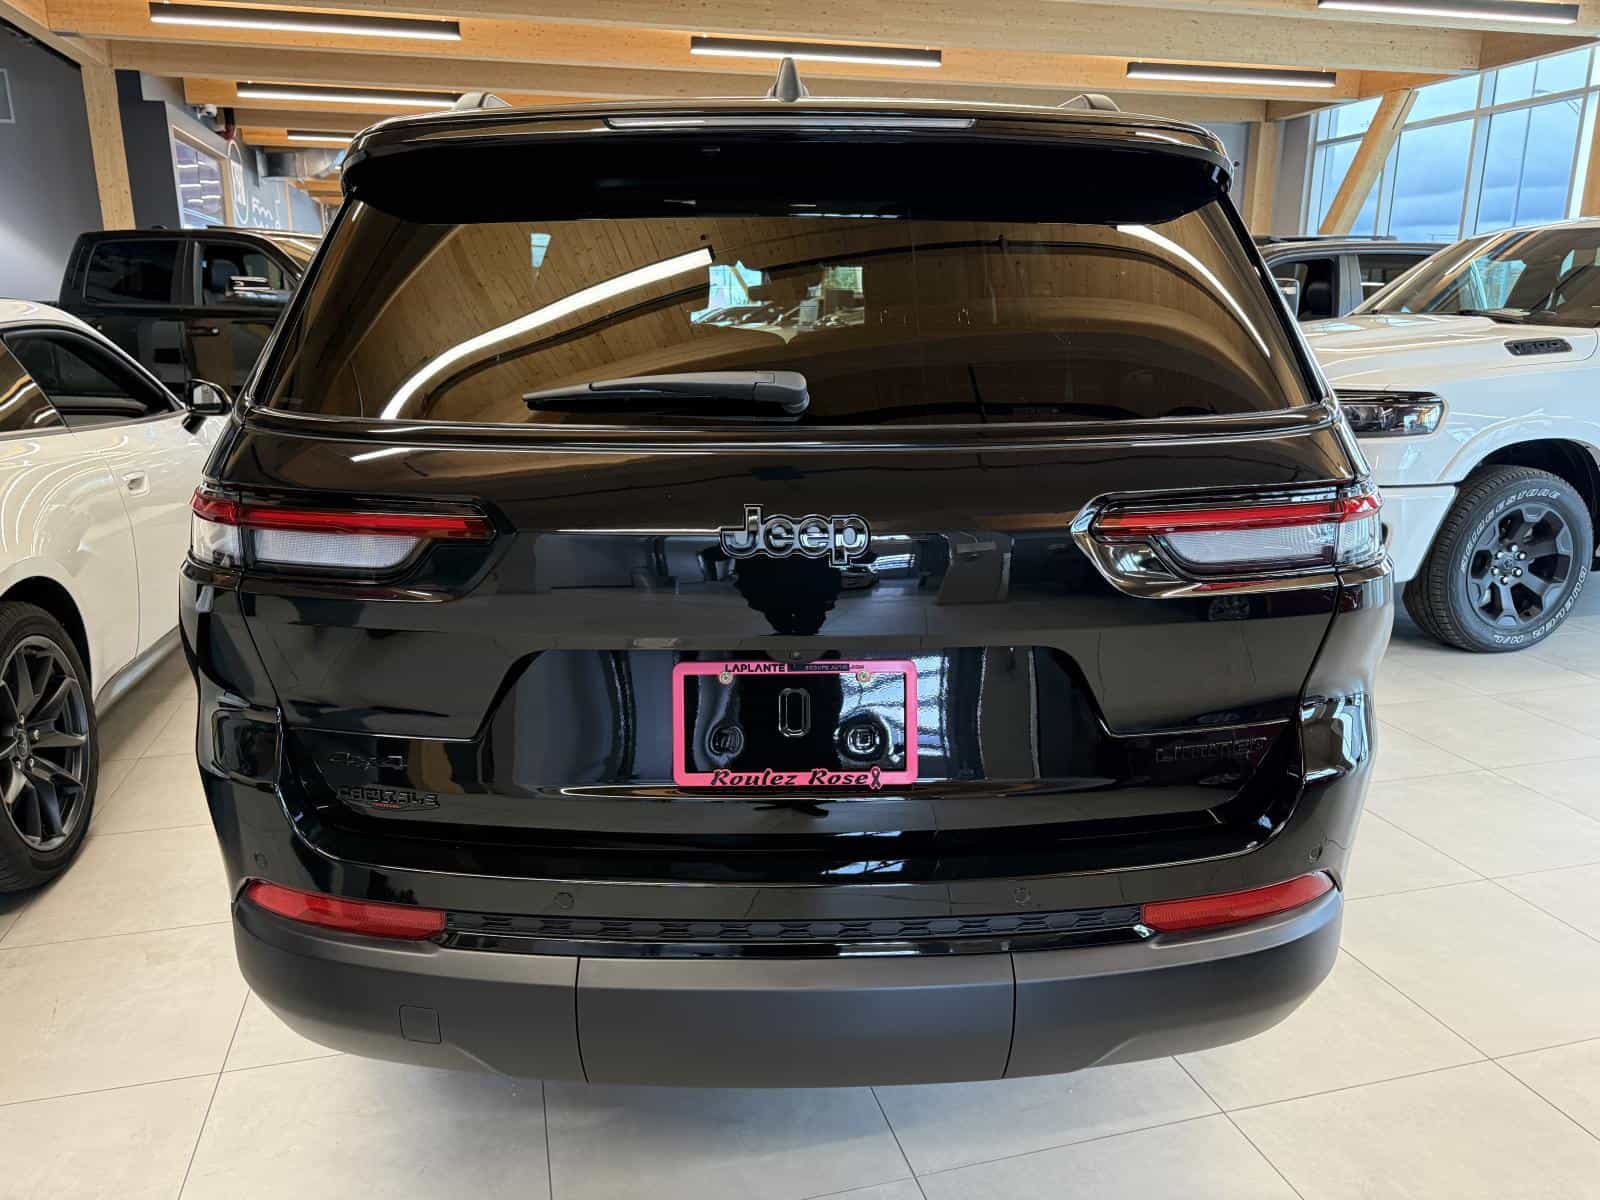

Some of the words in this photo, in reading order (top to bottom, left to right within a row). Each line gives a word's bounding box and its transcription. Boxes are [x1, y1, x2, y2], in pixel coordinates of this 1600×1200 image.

[720, 503, 871, 568] Jeep
[724, 663, 786, 673] LAPLANTE
[1155, 736, 1269, 764] LIMITED
[328, 751, 409, 770] 4x4
[710, 768, 797, 786] Roulez
[807, 768, 869, 786] Rose
